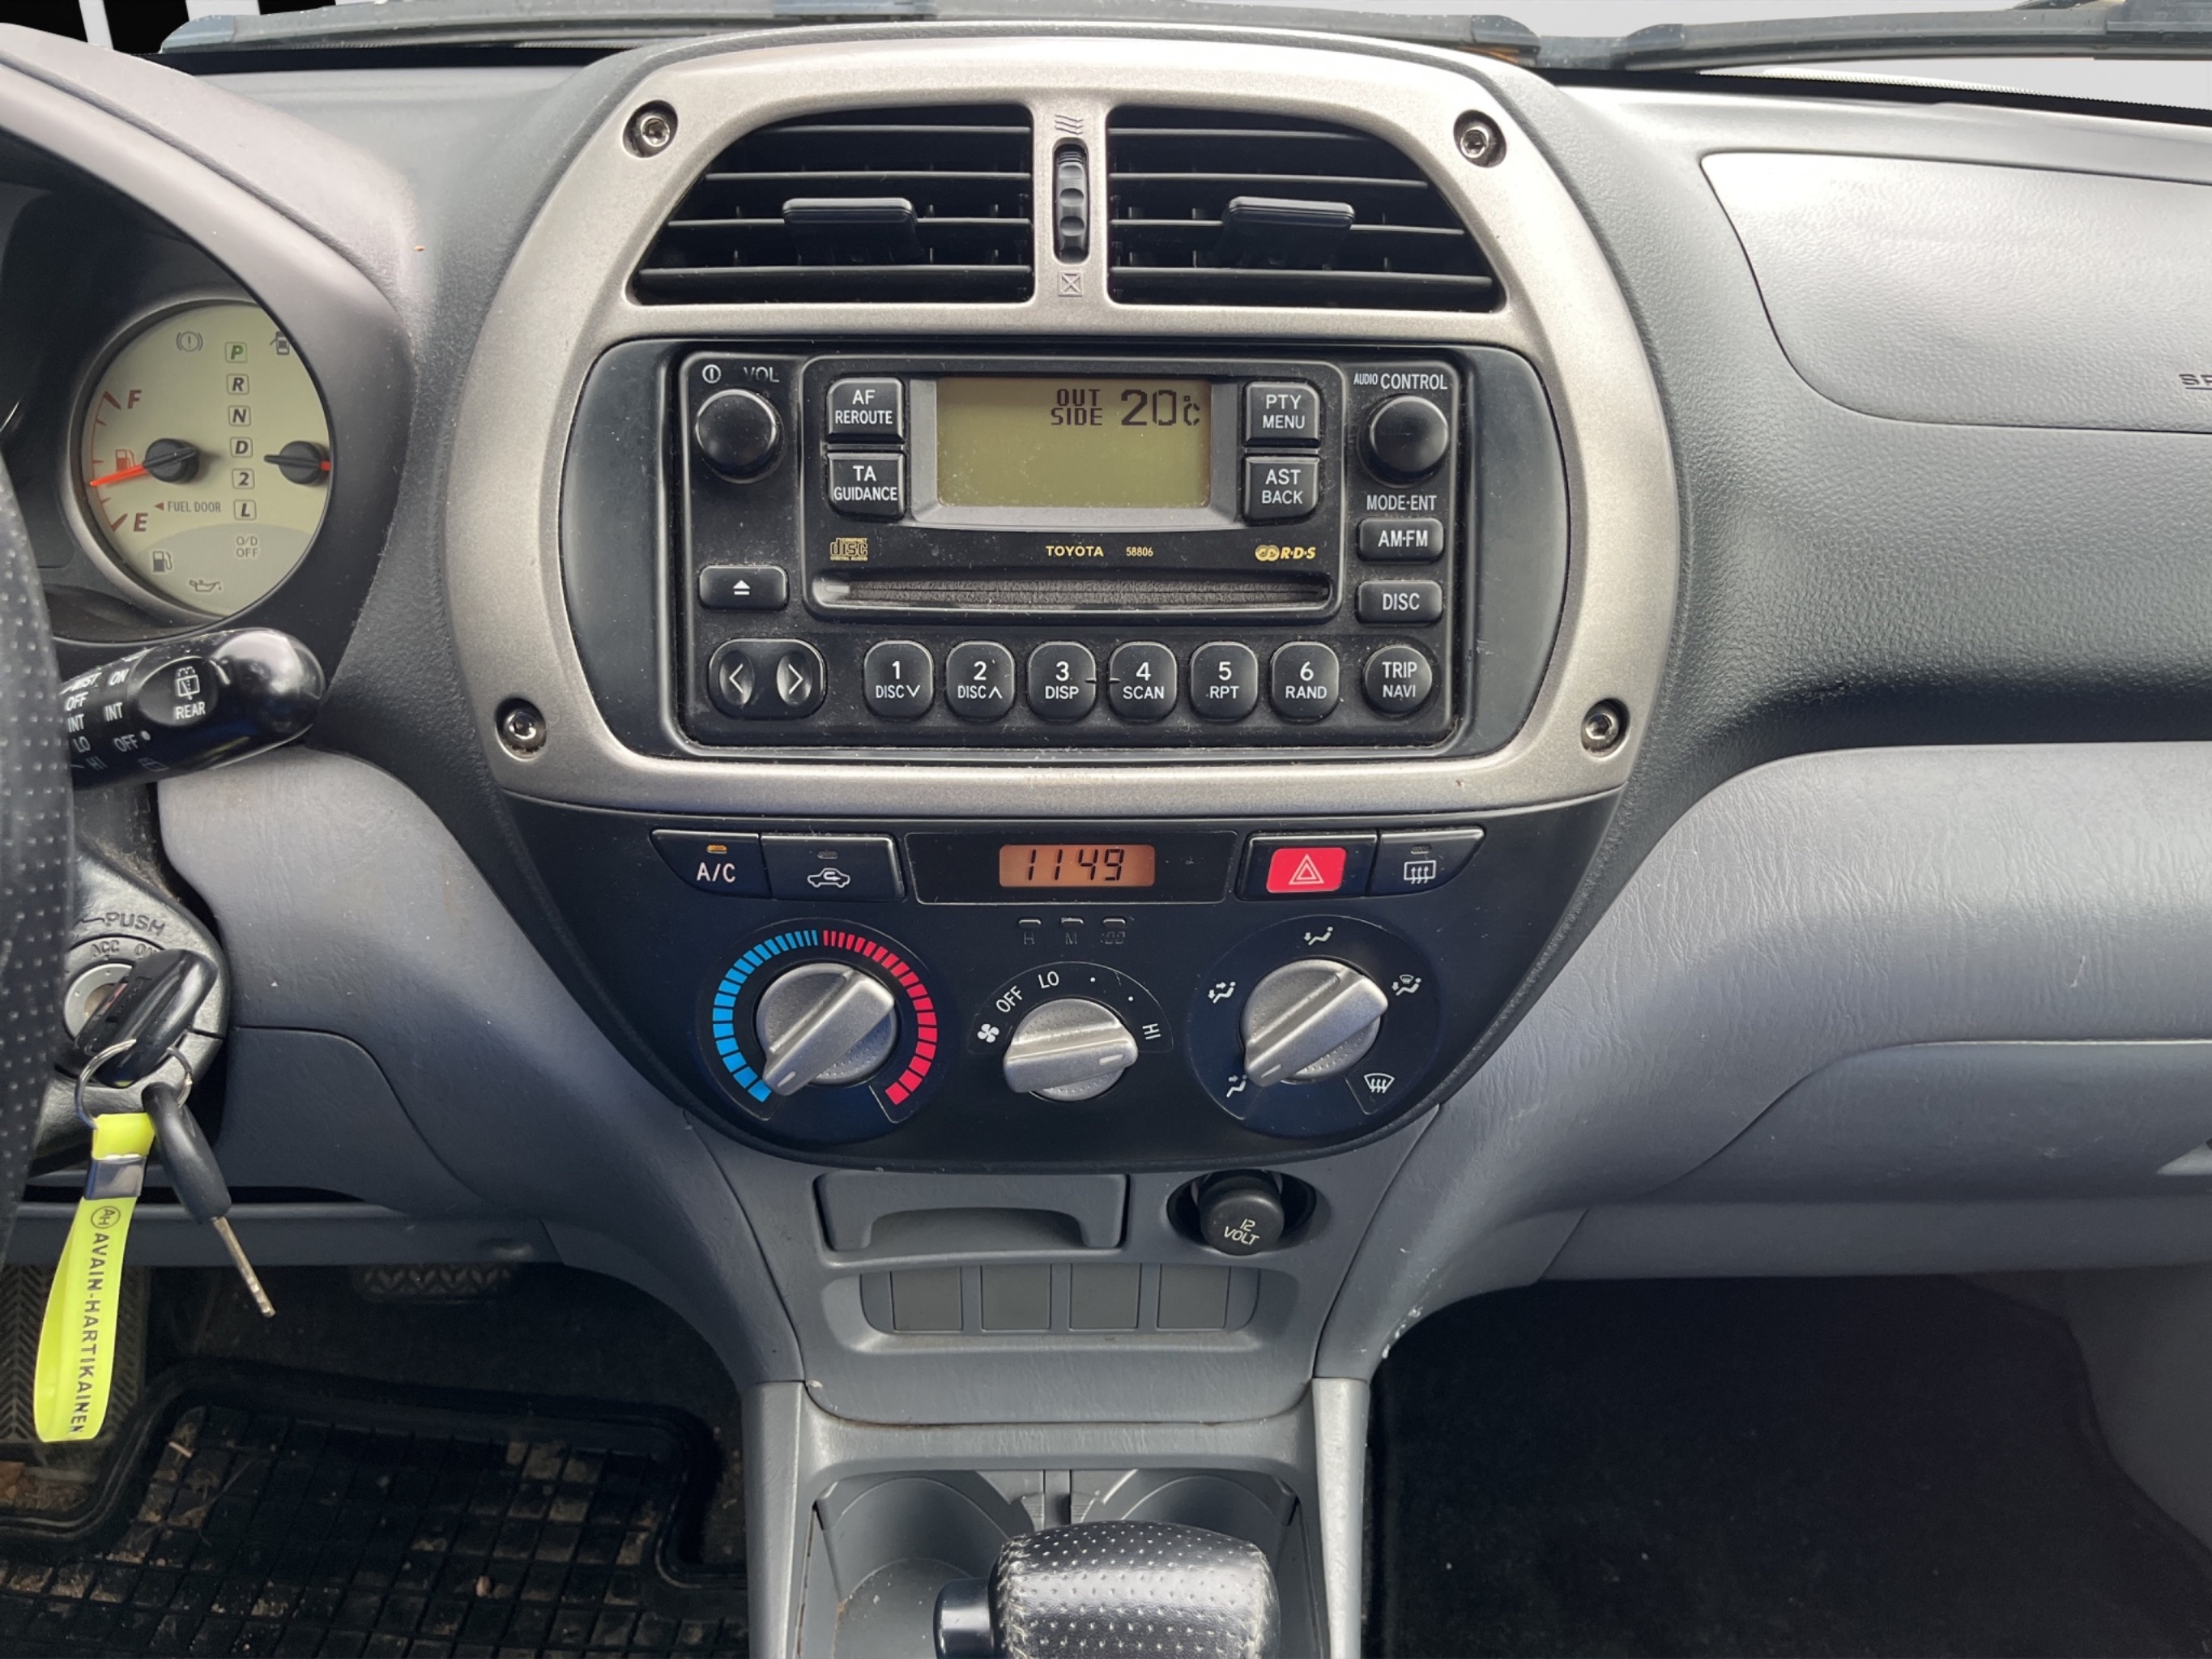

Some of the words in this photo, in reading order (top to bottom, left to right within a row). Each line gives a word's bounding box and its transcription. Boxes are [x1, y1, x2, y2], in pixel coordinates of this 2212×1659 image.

[230, 345, 244, 360] P
[744, 366, 779, 382] VOL
[1353, 373, 1378, 386] AUDIO
[1380, 373, 1448, 390] CONTROL
[232, 377, 245, 392] R
[127, 390, 142, 409] F
[852, 390, 876, 405] AF
[1056, 389, 1101, 407] OUT
[1265, 394, 1302, 410] PTY
[232, 408, 247, 424] N
[835, 410, 893, 424] REROUTE
[1051, 407, 1102, 425] SIDE
[1262, 414, 1306, 429] MENU
[235, 441, 249, 455] D
[238, 472, 249, 486] 2
[853, 466, 876, 481] TA
[1265, 469, 1301, 485] AST
[833, 486, 897, 501] GUIDANCE
[1261, 489, 1303, 505] BACK
[168, 501, 191, 512] FUEL
[194, 501, 221, 513] DOOR
[241, 503, 250, 518] L
[134, 513, 148, 532] E
[237, 536, 258, 546] O/D
[237, 548, 258, 557] OFF
[1045, 545, 1105, 557] TOYOTA
[1126, 546, 1154, 557] 58806
[1382, 593, 1421, 611] DISC
[109, 668, 130, 686] ON
[892, 661, 901, 680] 1
[974, 661, 987, 680] 2
[1055, 661, 1069, 681] 3
[1136, 661, 1151, 680] 4
[1218, 661, 1232, 680] 5
[1300, 661, 1314, 680] 6
[1382, 662, 1417, 679] TRIP
[1045, 685, 1079, 699] DISP
[1123, 685, 1165, 699] SCAN
[1209, 685, 1239, 699] RPT
[1285, 685, 1328, 699] RAND
[1382, 683, 1417, 698] NAVI
[65, 691, 89, 711] OFF
[104, 702, 123, 722] INT
[176, 702, 206, 719] REAR
[68, 714, 85, 732] INT
[73, 736, 91, 753] LO
[114, 734, 139, 752] OFF
[86, 756, 108, 770] HI
[697, 862, 735, 883] A/C
[105, 912, 166, 936] PUSH
[90, 940, 120, 957] ACC
[1038, 970, 1059, 989] LO
[995, 986, 1023, 1013] OFF
[1142, 1023, 1161, 1040] HI
[1239, 1218, 1256, 1232] 12
[1224, 1226, 1260, 1246] VOLT
